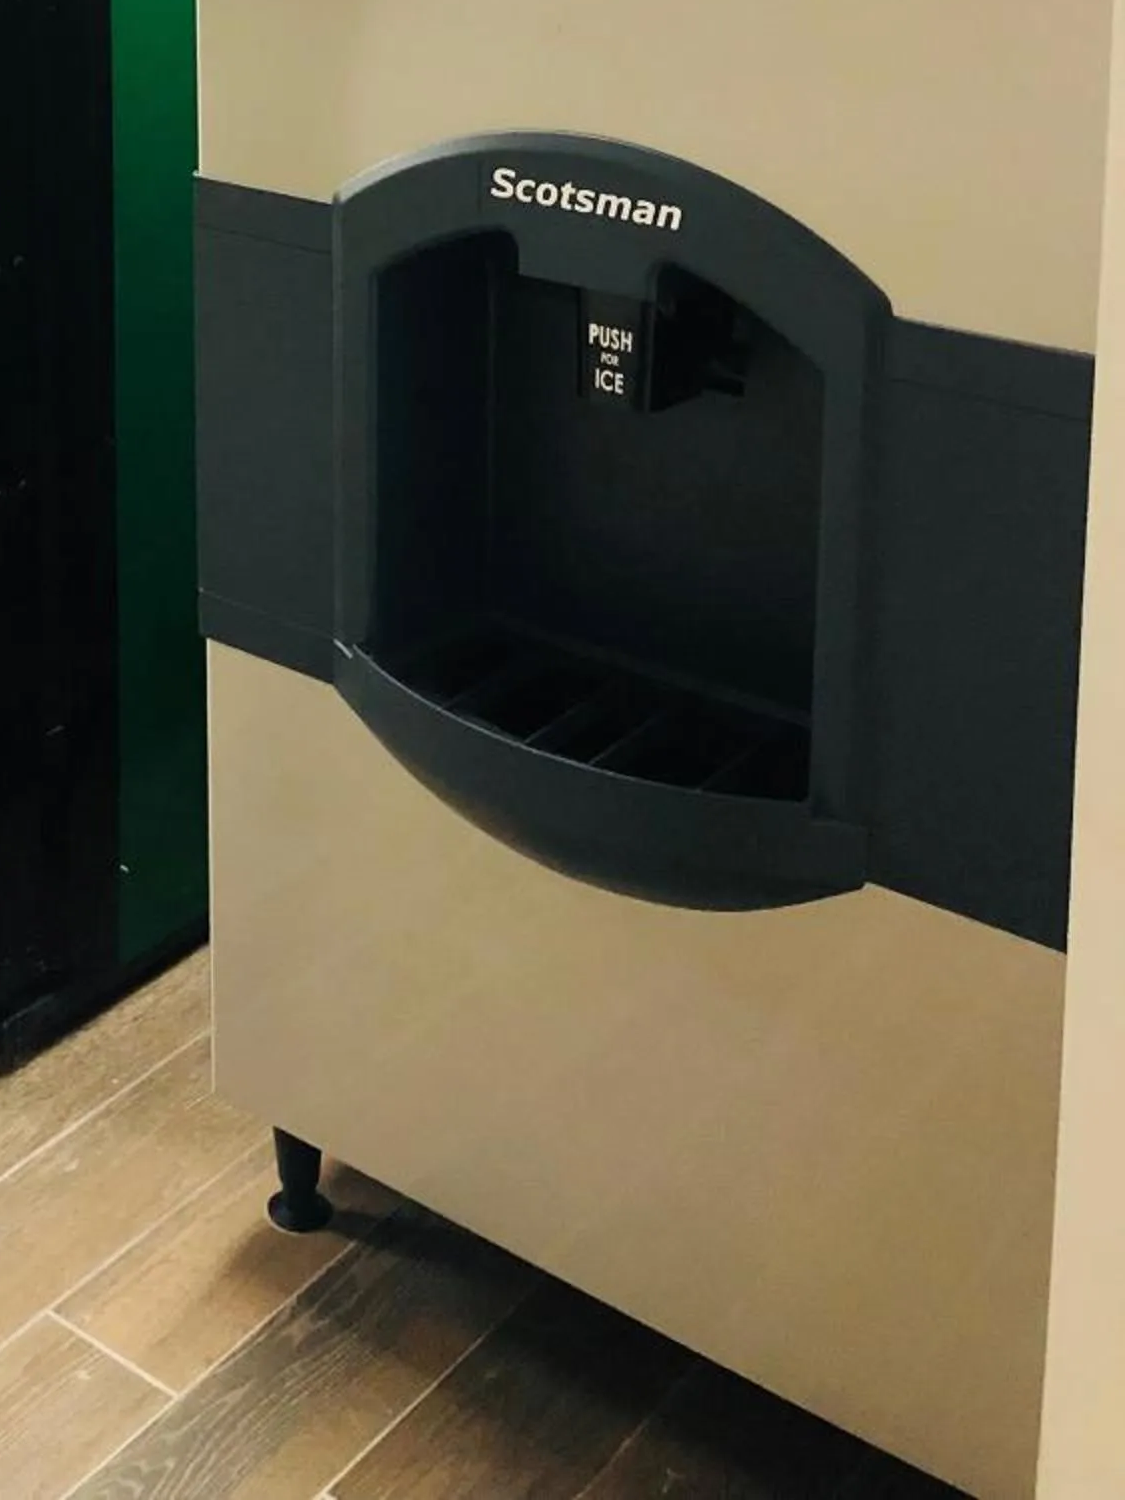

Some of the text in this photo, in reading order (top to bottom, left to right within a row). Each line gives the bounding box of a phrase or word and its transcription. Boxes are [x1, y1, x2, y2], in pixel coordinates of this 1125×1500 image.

[490, 167, 682, 231] Scotsman
[588, 323, 633, 352] PUSH
[600, 352, 619, 367] FOR
[595, 368, 624, 394] ICE
